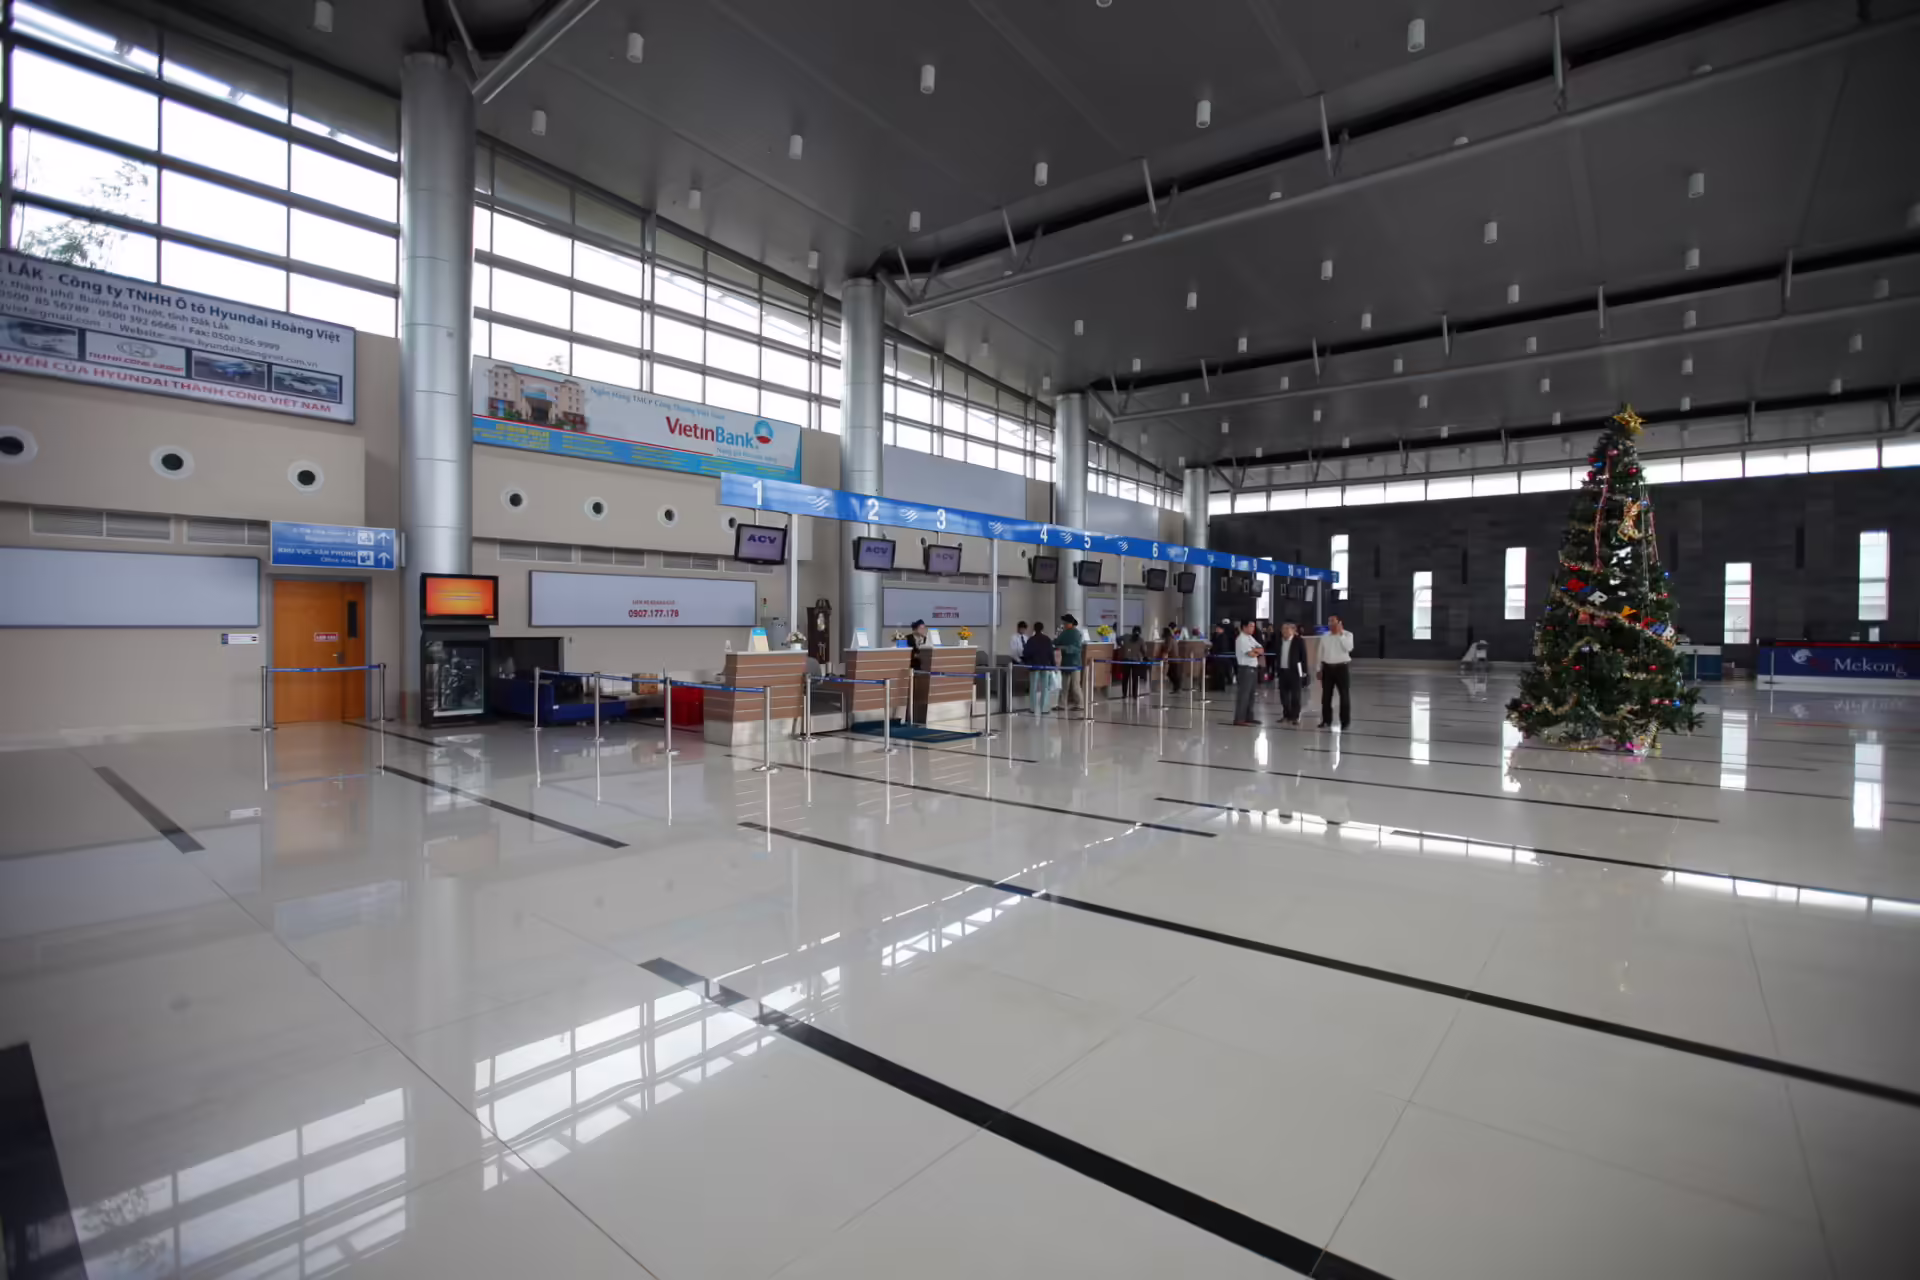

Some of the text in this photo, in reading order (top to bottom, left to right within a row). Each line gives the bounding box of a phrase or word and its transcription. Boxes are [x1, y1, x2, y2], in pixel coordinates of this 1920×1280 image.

[58, 273, 102, 294] Công
[107, 284, 122, 299] ty
[126, 287, 171, 307] TNHH
[191, 303, 206, 314] tô
[209, 305, 268, 327] Hyundai
[271, 319, 313, 339] Hoàng
[316, 328, 340, 343] Việt
[189, 326, 209, 338] Fax:
[212, 331, 235, 342] 0500
[93, 366, 168, 387] HYUNDAI
[172, 380, 224, 397] THÀNH
[227, 387, 267, 402] CÔNG
[301, 402, 332, 413] NAM
[665, 416, 754, 449] VietinBank
[752, 479, 764, 506] 1
[867, 498, 879, 520] 2
[936, 508, 946, 529] 3
[747, 533, 776, 544] ACV
[1040, 523, 1048, 543] 4
[1084, 532, 1091, 549] 5
[865, 545, 888, 555] ACV
[1152, 542, 1159, 558] 6
[628, 609, 679, 618] 0907.177.178
[1834, 657, 1907, 678] Mekong
